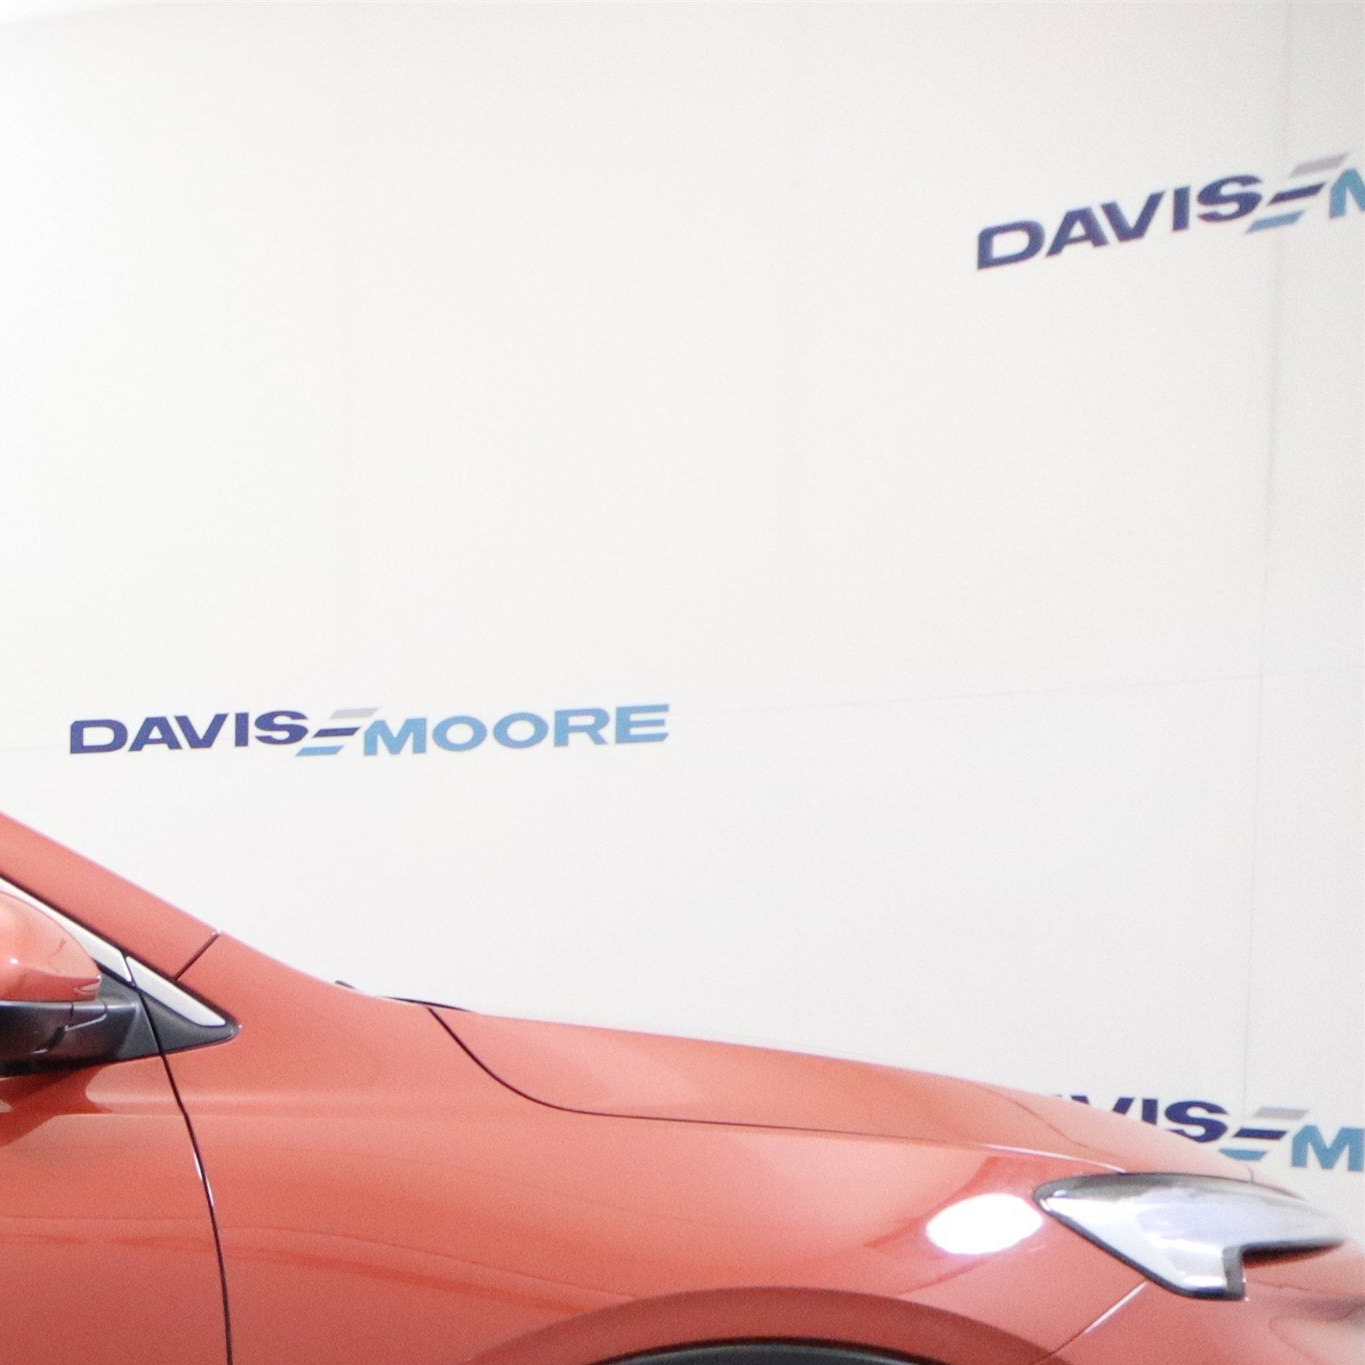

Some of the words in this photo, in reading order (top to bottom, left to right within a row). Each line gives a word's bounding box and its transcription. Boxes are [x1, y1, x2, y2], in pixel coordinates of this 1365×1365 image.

[976, 174, 1263, 270] DAVIS
[69, 709, 309, 755] DAVIS
[363, 703, 670, 757] MOORE
